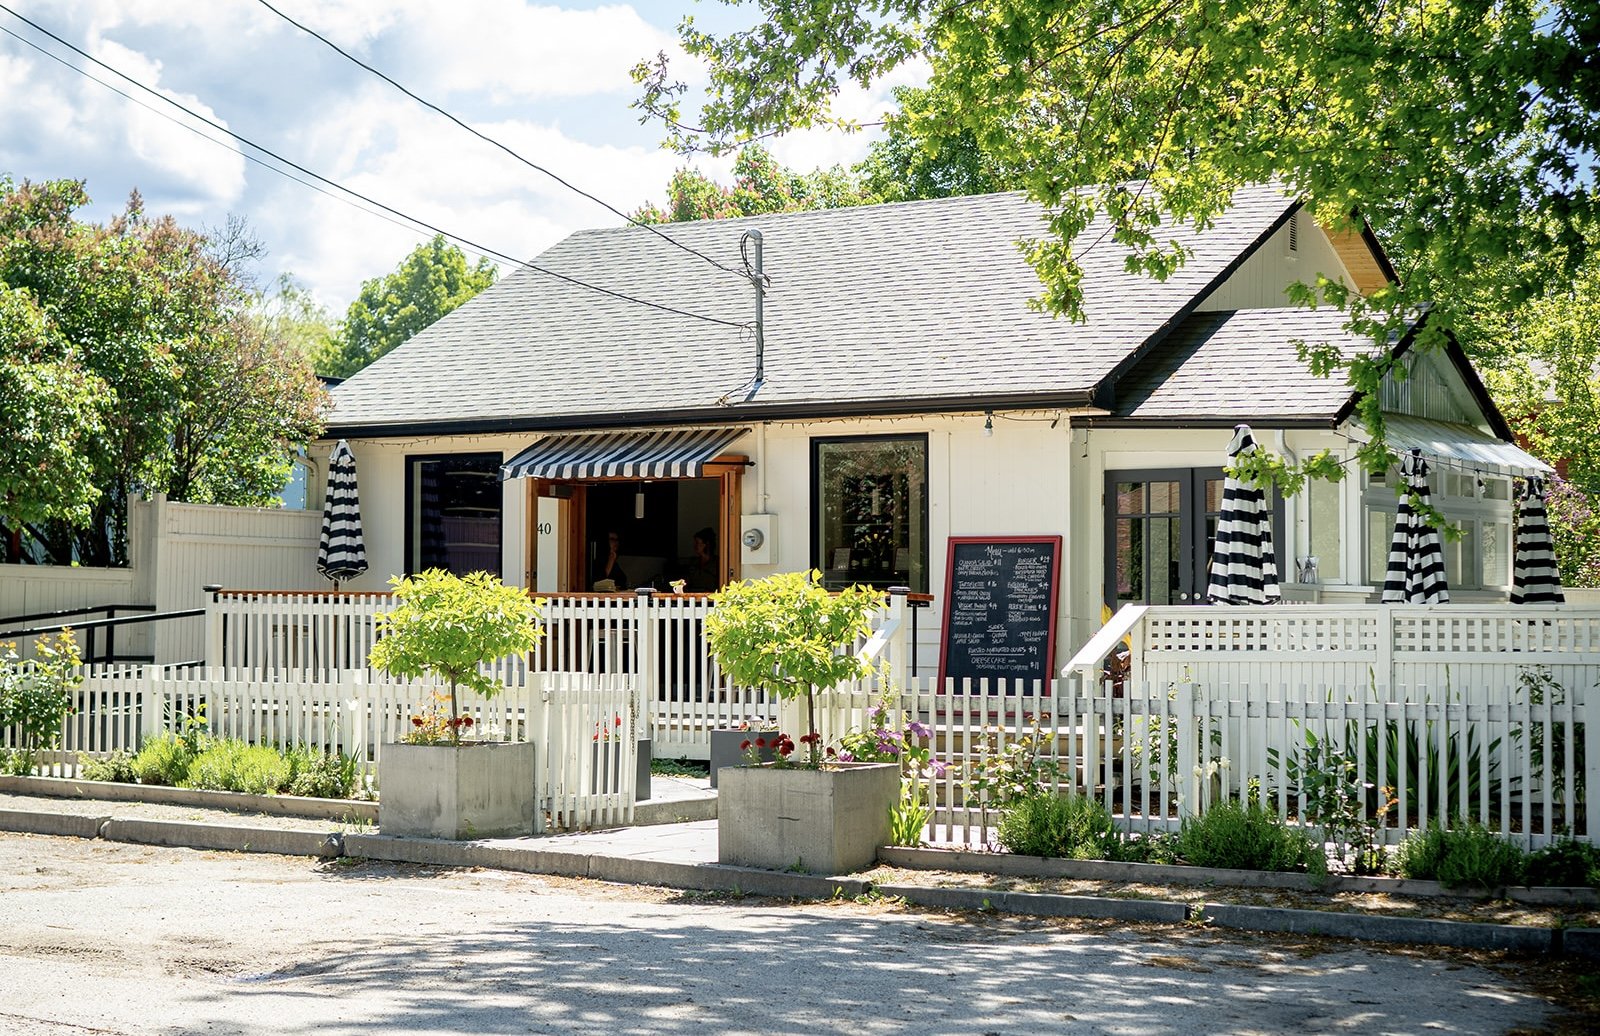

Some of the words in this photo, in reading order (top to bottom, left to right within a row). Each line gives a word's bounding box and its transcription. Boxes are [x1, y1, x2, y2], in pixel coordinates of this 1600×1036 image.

[537, 522, 552, 535] 40
[985, 545, 1003, 560] Menu
[1029, 646, 1037, 655] $9
